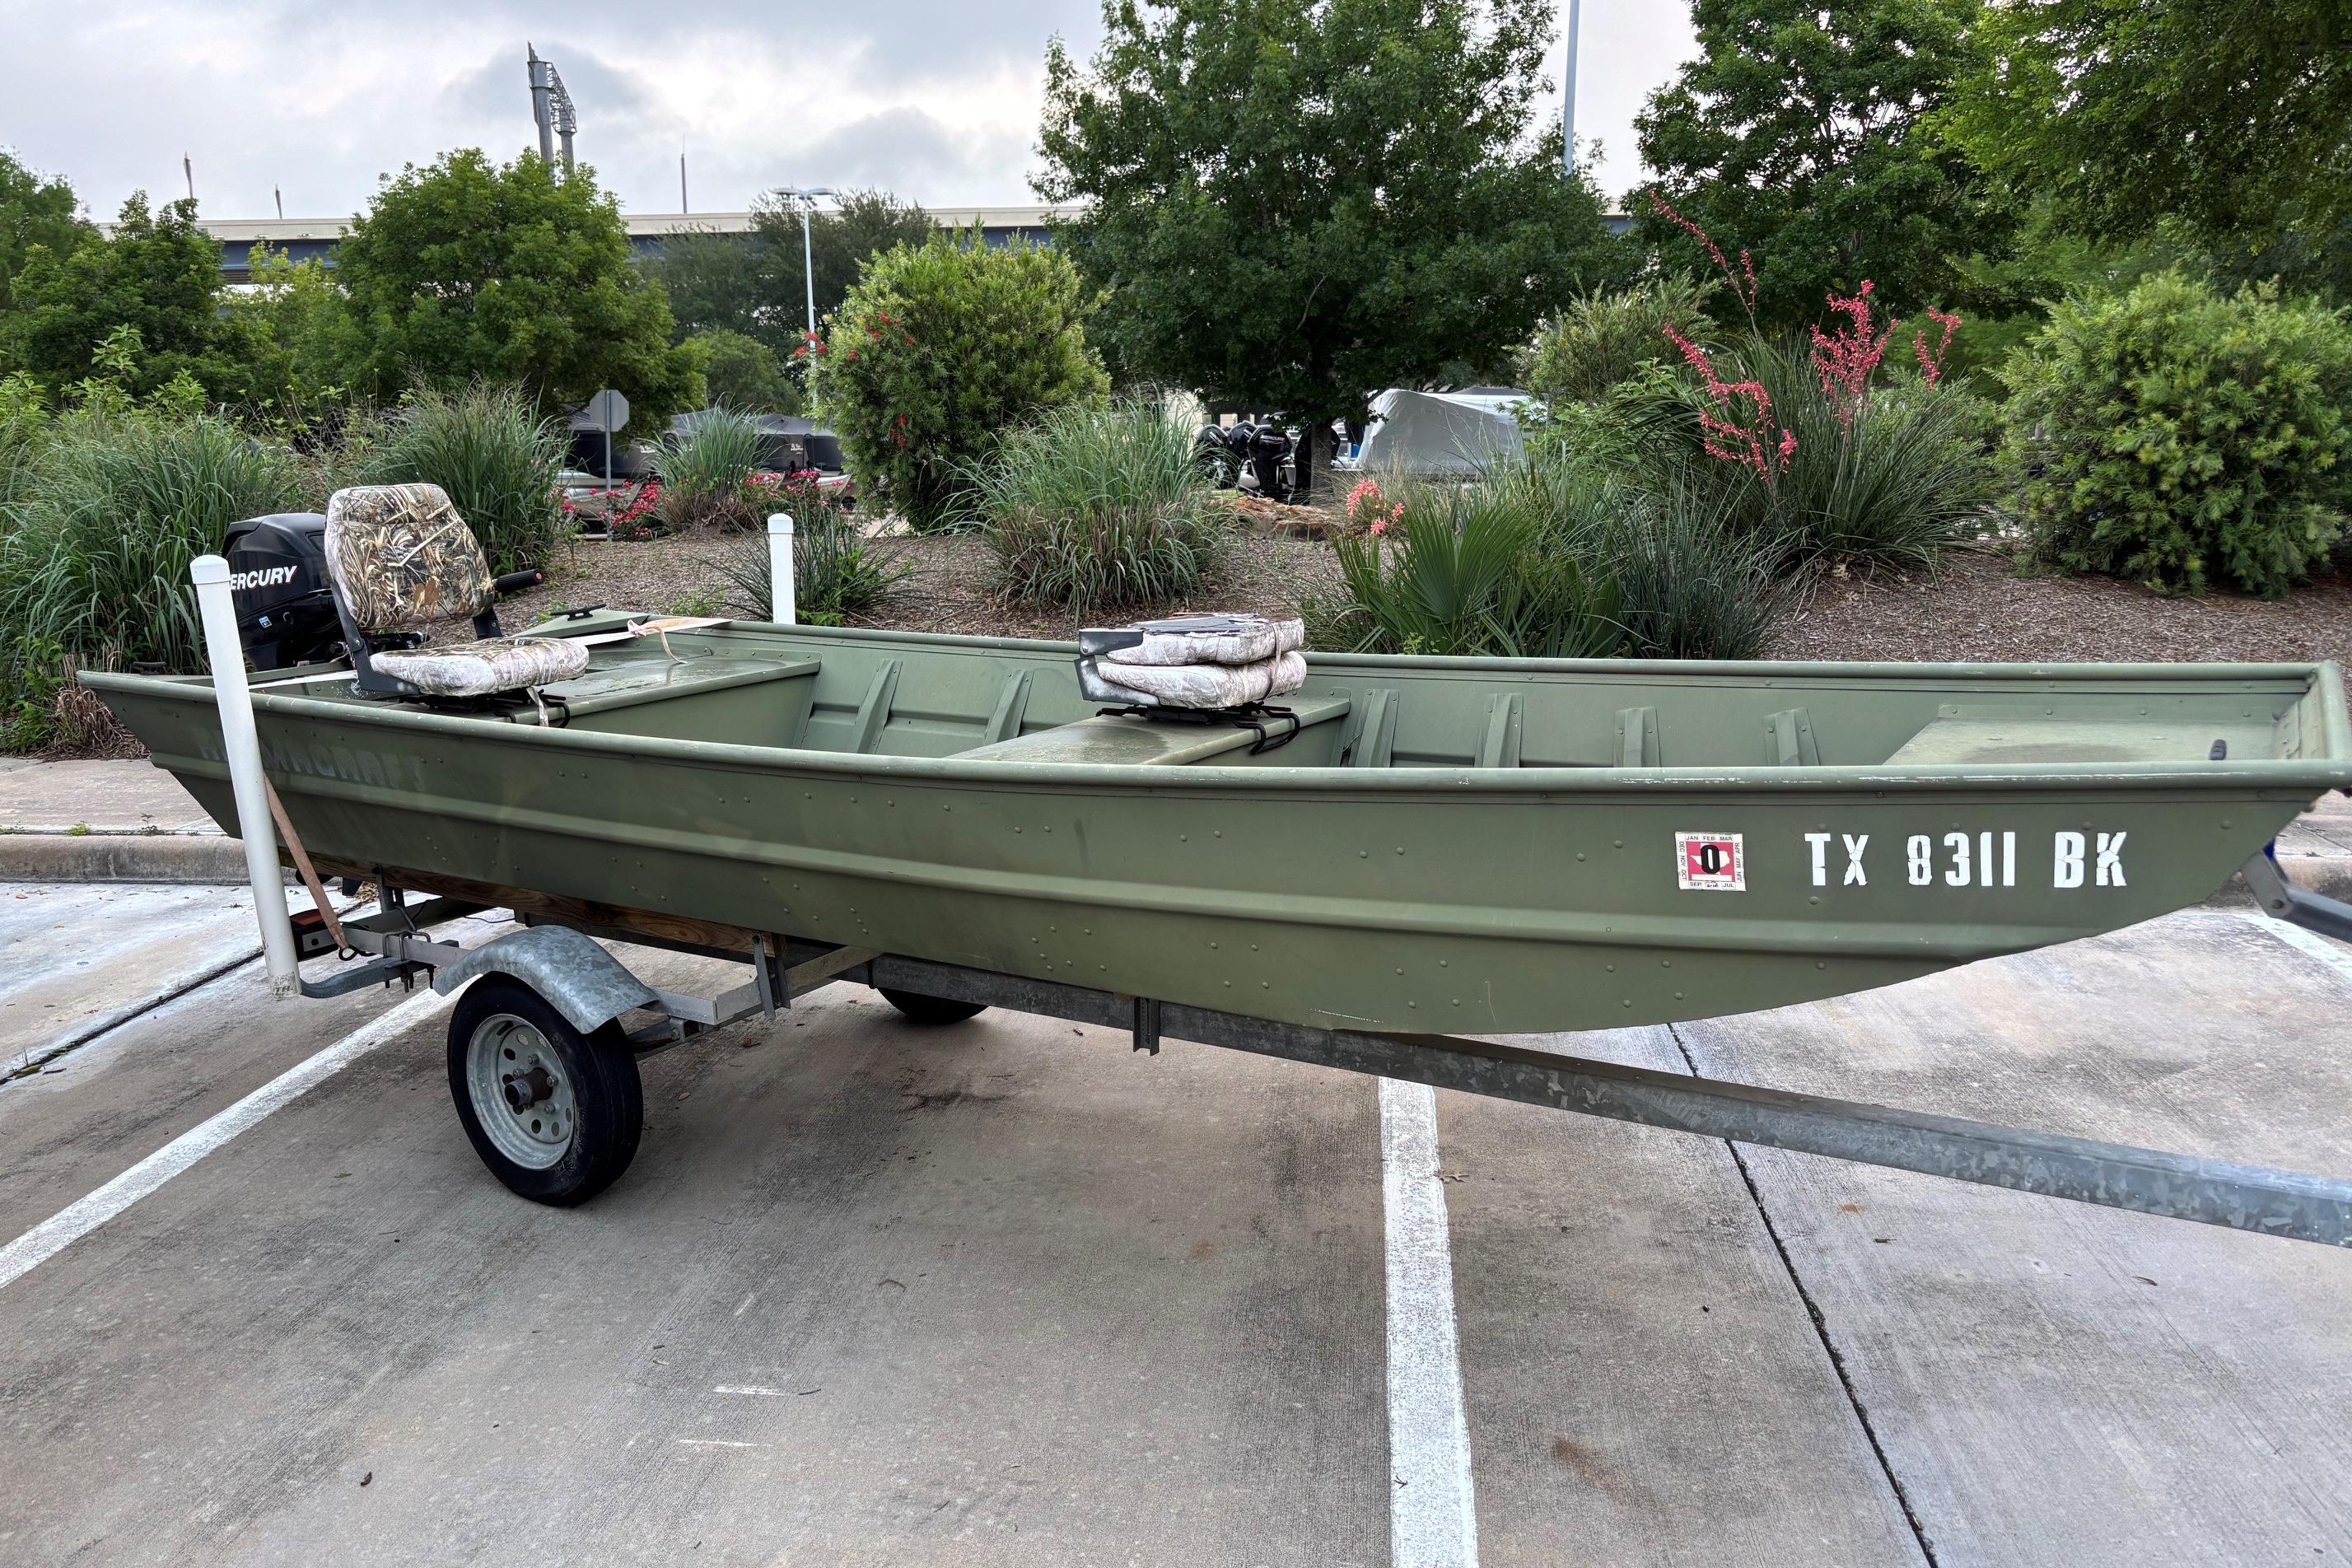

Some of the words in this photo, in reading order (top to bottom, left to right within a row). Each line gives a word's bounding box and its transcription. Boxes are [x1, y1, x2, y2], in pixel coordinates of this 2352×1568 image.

[231, 566, 297, 590] ERCURY
[1804, 833, 1869, 887] TX
[1906, 832, 2016, 887] 8311
[2053, 831, 2128, 888] BK
